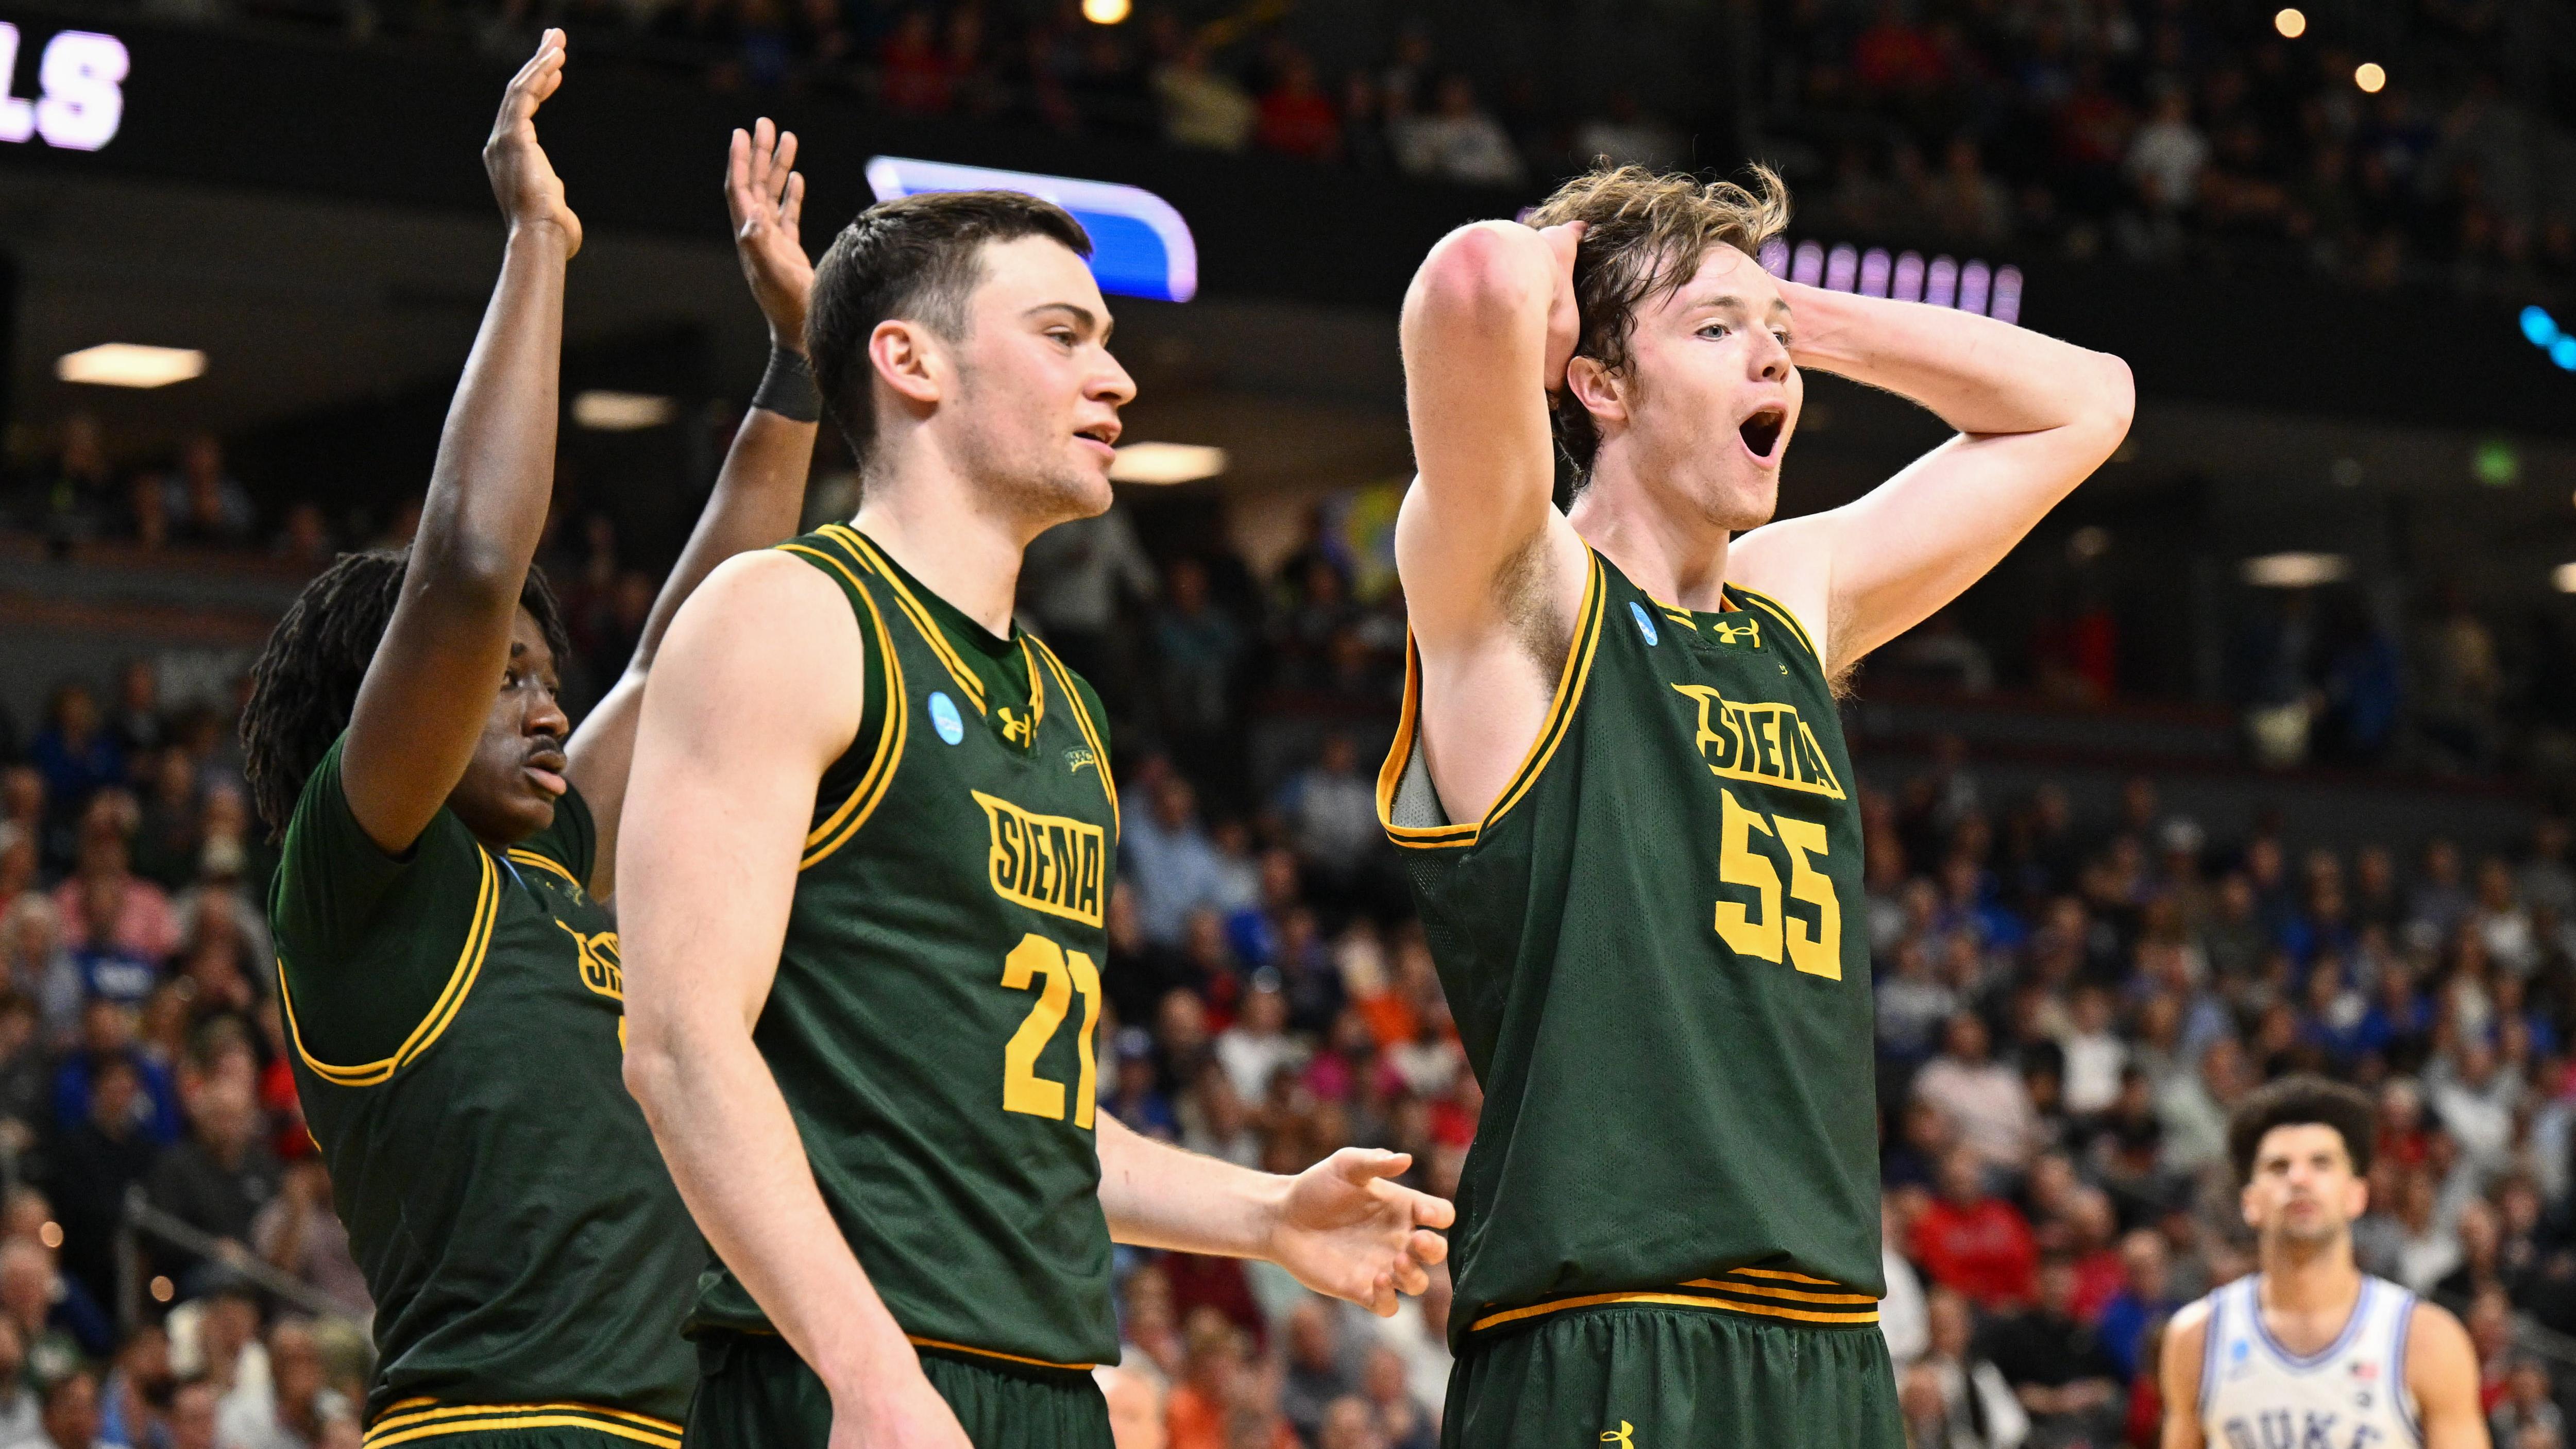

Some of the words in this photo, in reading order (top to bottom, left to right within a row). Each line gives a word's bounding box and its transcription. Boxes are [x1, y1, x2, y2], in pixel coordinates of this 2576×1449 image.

[1701, 694, 1838, 790] SIENA
[995, 806, 1098, 916] SIENA
[1715, 788, 1841, 981] 55
[1001, 933, 1101, 1129] 21
